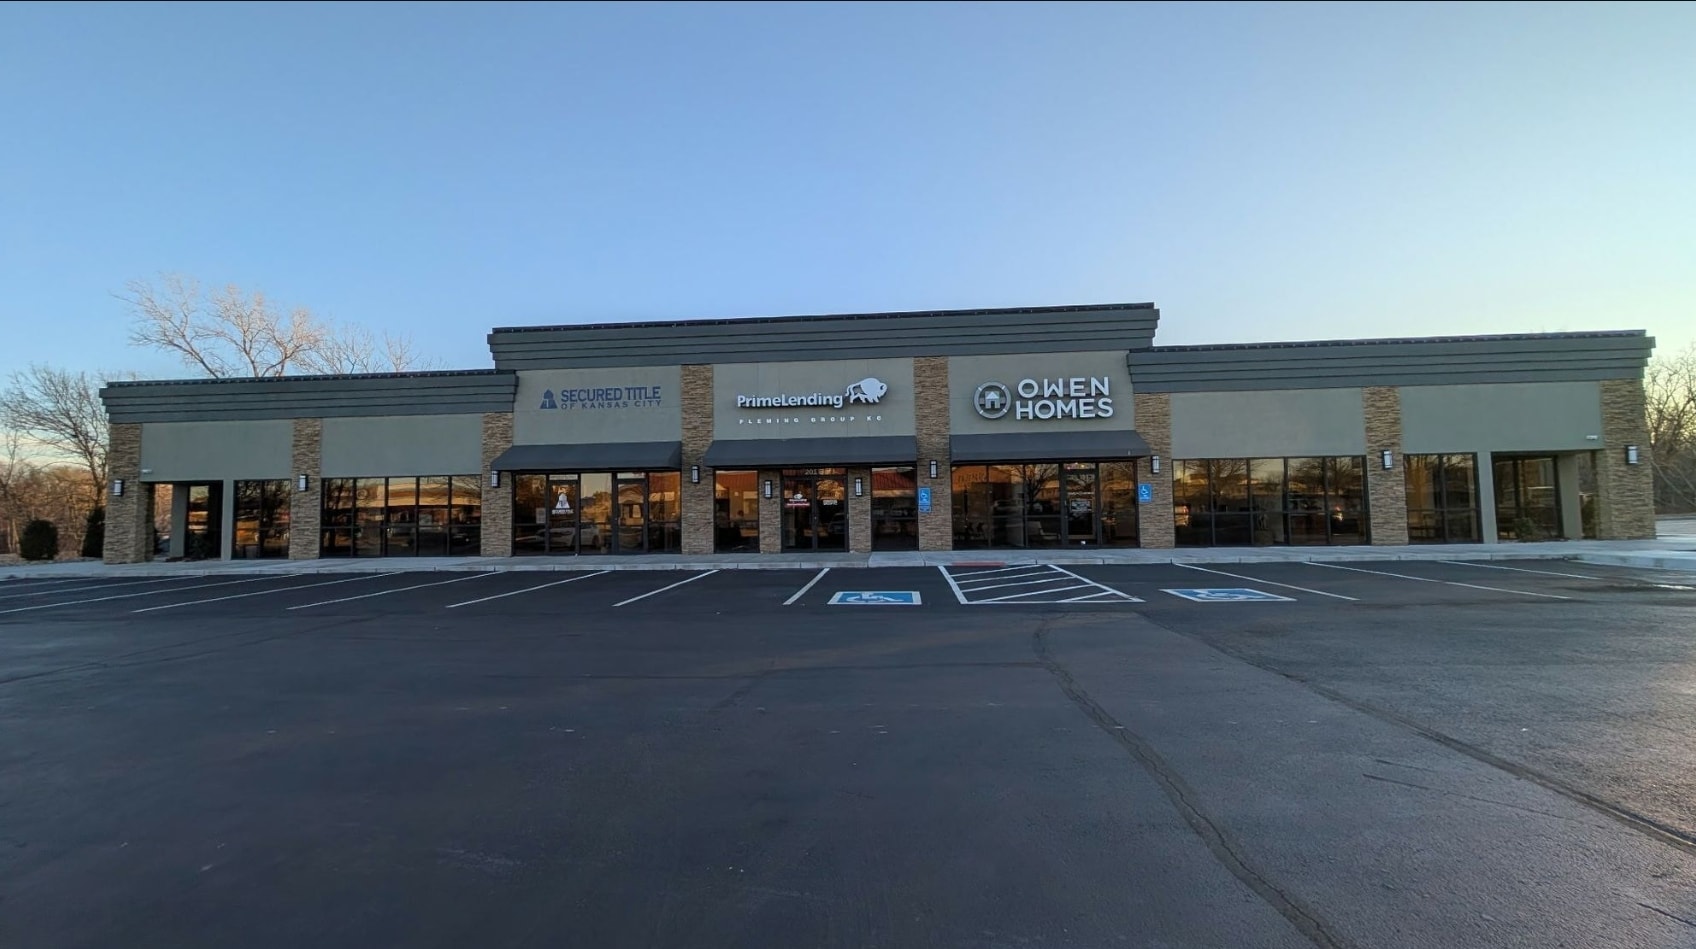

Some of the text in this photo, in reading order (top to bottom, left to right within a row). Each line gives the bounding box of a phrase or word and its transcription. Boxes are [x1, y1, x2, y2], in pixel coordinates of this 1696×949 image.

[561, 386, 661, 402] SECURED TITLE
[1017, 376, 1110, 398] OWEN
[561, 399, 661, 410] OF KANSAS CITY
[736, 392, 844, 409] PrimeLending
[1015, 397, 1114, 420] HOMES
